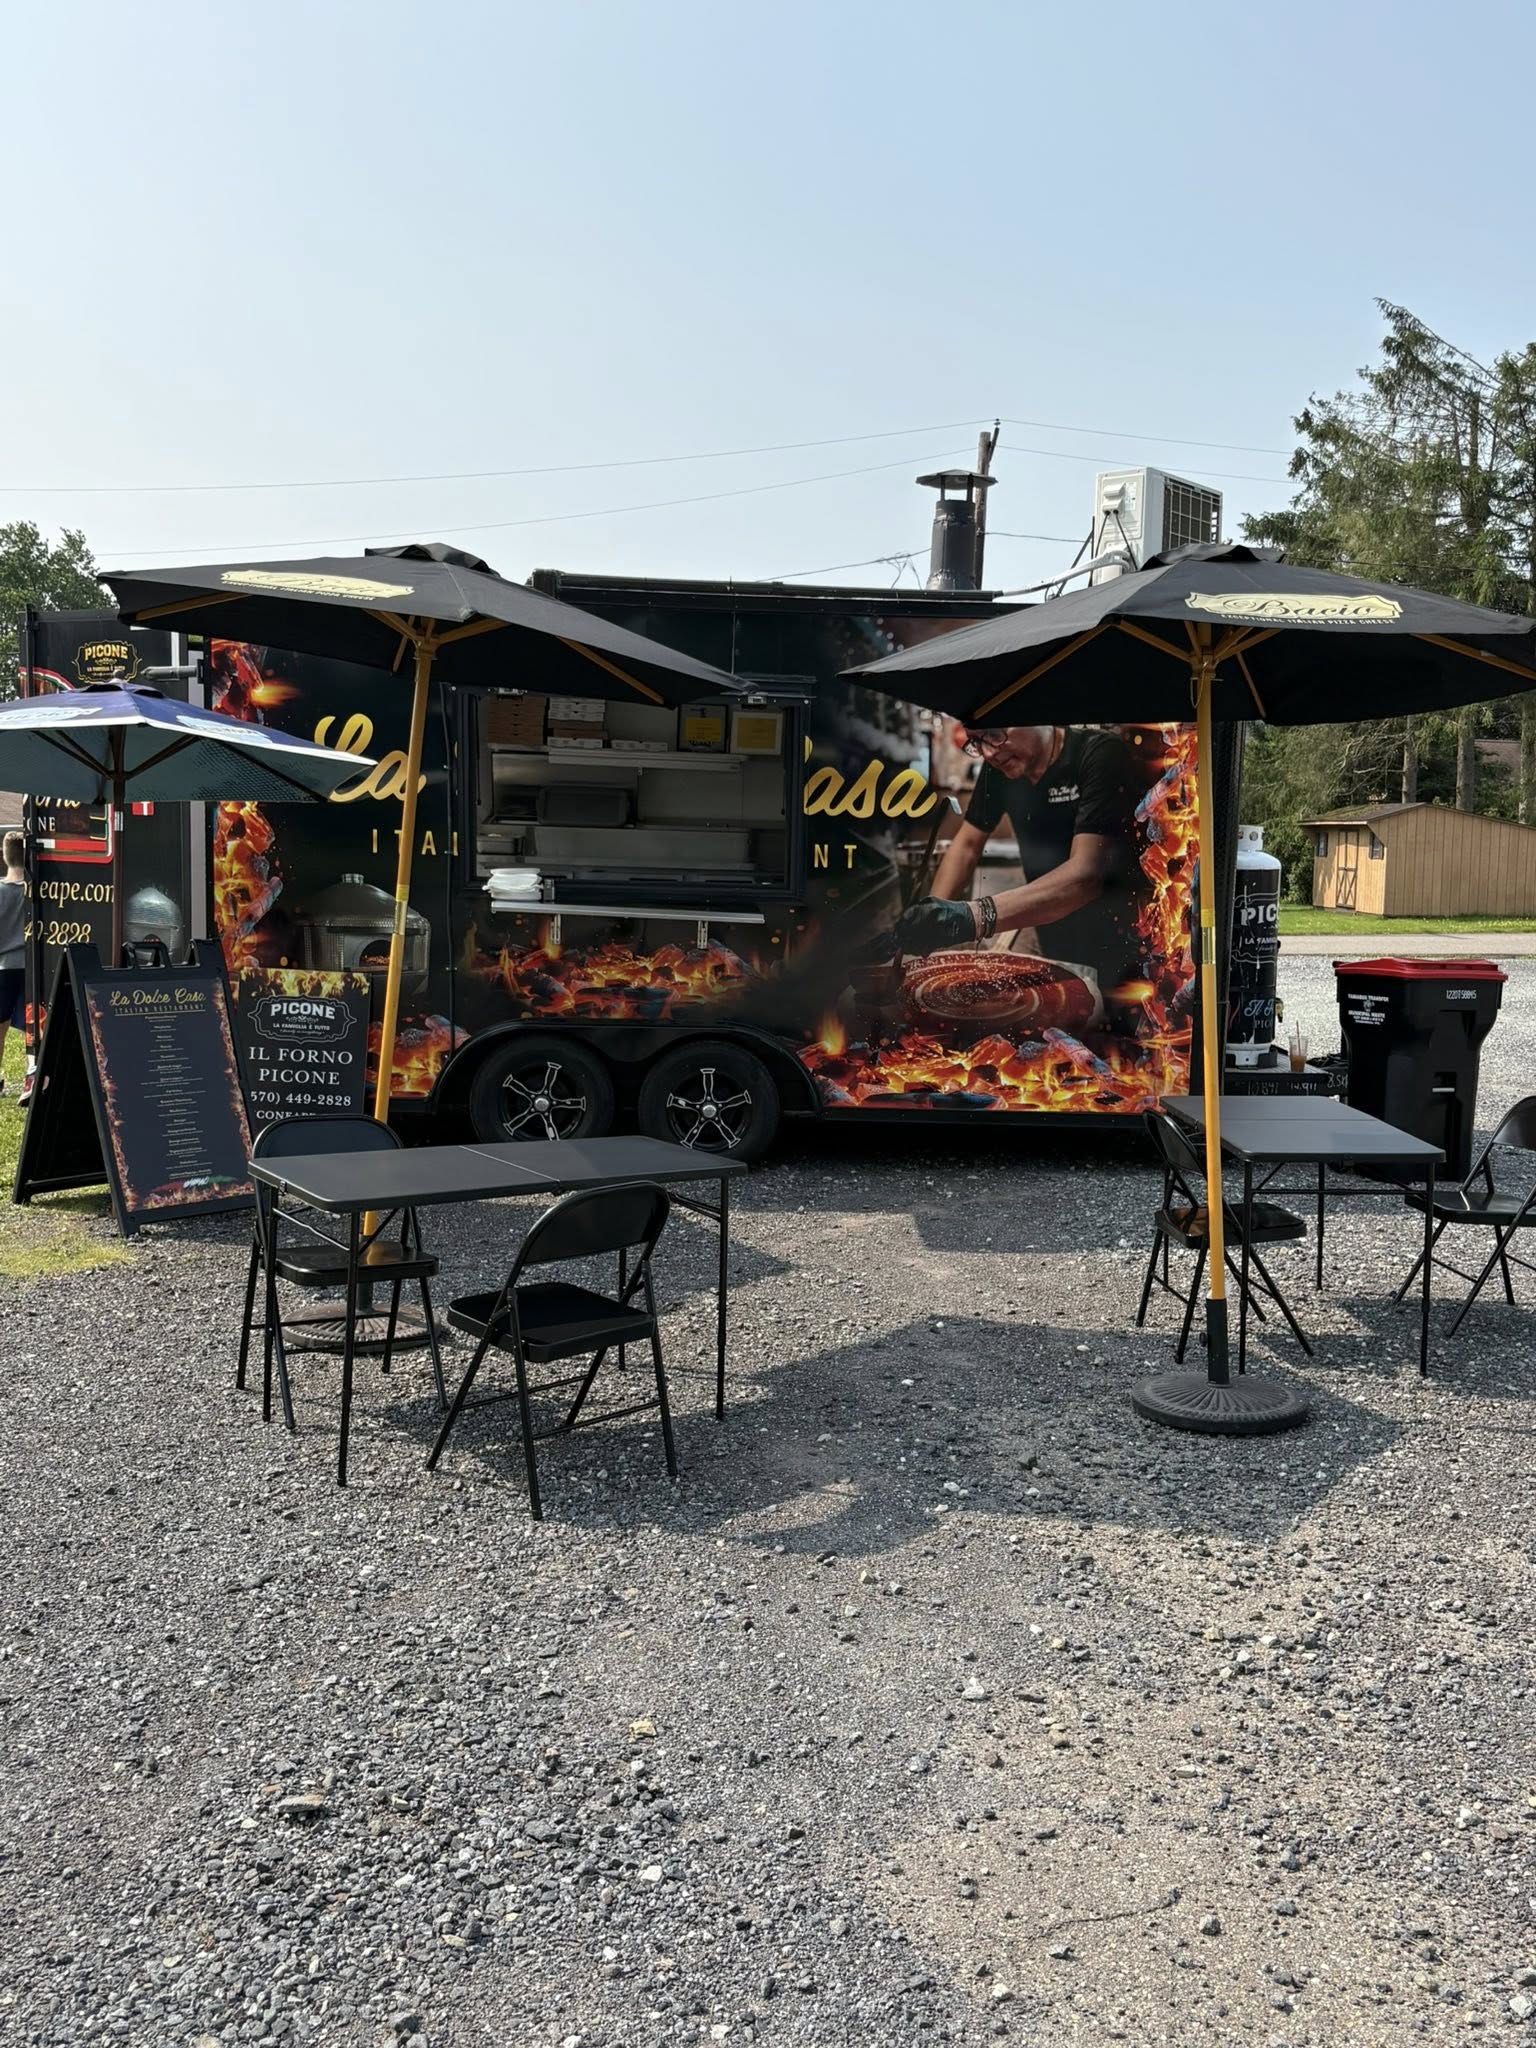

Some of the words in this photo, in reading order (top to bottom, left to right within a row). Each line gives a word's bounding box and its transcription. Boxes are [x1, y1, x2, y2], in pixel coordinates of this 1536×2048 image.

[1222, 599, 1372, 618] Bacio
[1221, 614, 1285, 623] EXCEPTIONAL
[84, 644, 128, 661] PICONE
[803, 736, 938, 819] asa
[109, 990, 131, 1006] La
[132, 988, 171, 1005] Dolce
[174, 987, 207, 1004] Casa
[270, 1002, 335, 1020] PICONE
[248, 1046, 271, 1061] IL
[278, 1048, 354, 1065] FORNO
[258, 1068, 341, 1085] PICONE
[285, 1093, 352, 1107] 449-2828
